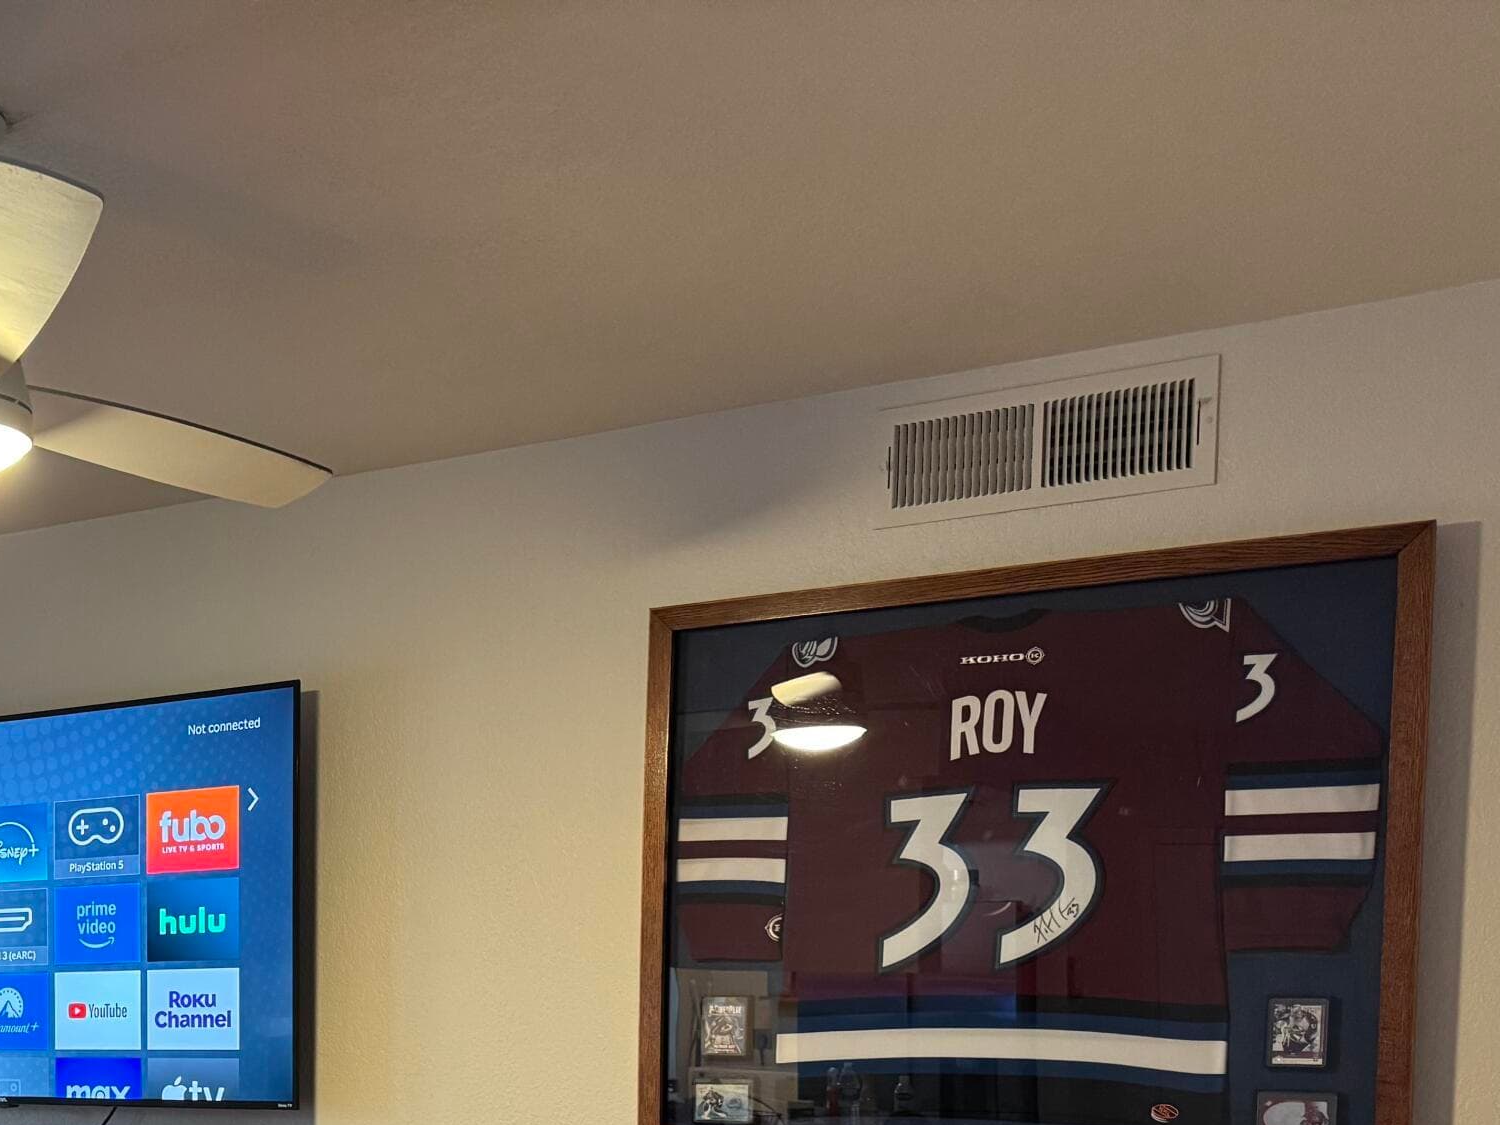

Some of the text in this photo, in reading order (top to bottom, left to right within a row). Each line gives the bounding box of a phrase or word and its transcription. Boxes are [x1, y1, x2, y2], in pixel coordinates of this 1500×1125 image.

[960, 653, 1025, 665] KOHO
[1236, 653, 1278, 723] 3
[188, 717, 261, 736] Not connected
[949, 689, 1048, 761] ROY
[159, 809, 226, 843] fubo
[162, 846, 178, 854] LIVE
[179, 845, 188, 853] TV
[196, 842, 225, 851] SPORTS
[69, 860, 124, 874] PlayStation 5
[880, 786, 1102, 969] 33
[76, 901, 117, 920] prime
[77, 919, 116, 935] video
[159, 906, 226, 935] hulu
[2, 951, 8, 960] 3
[9, 950, 37, 961] (eARC)
[168, 990, 217, 1008] Roku
[88, 1003, 128, 1019] YouTube
[154, 1009, 232, 1029] Channel
[188, 1080, 225, 1101] tv
